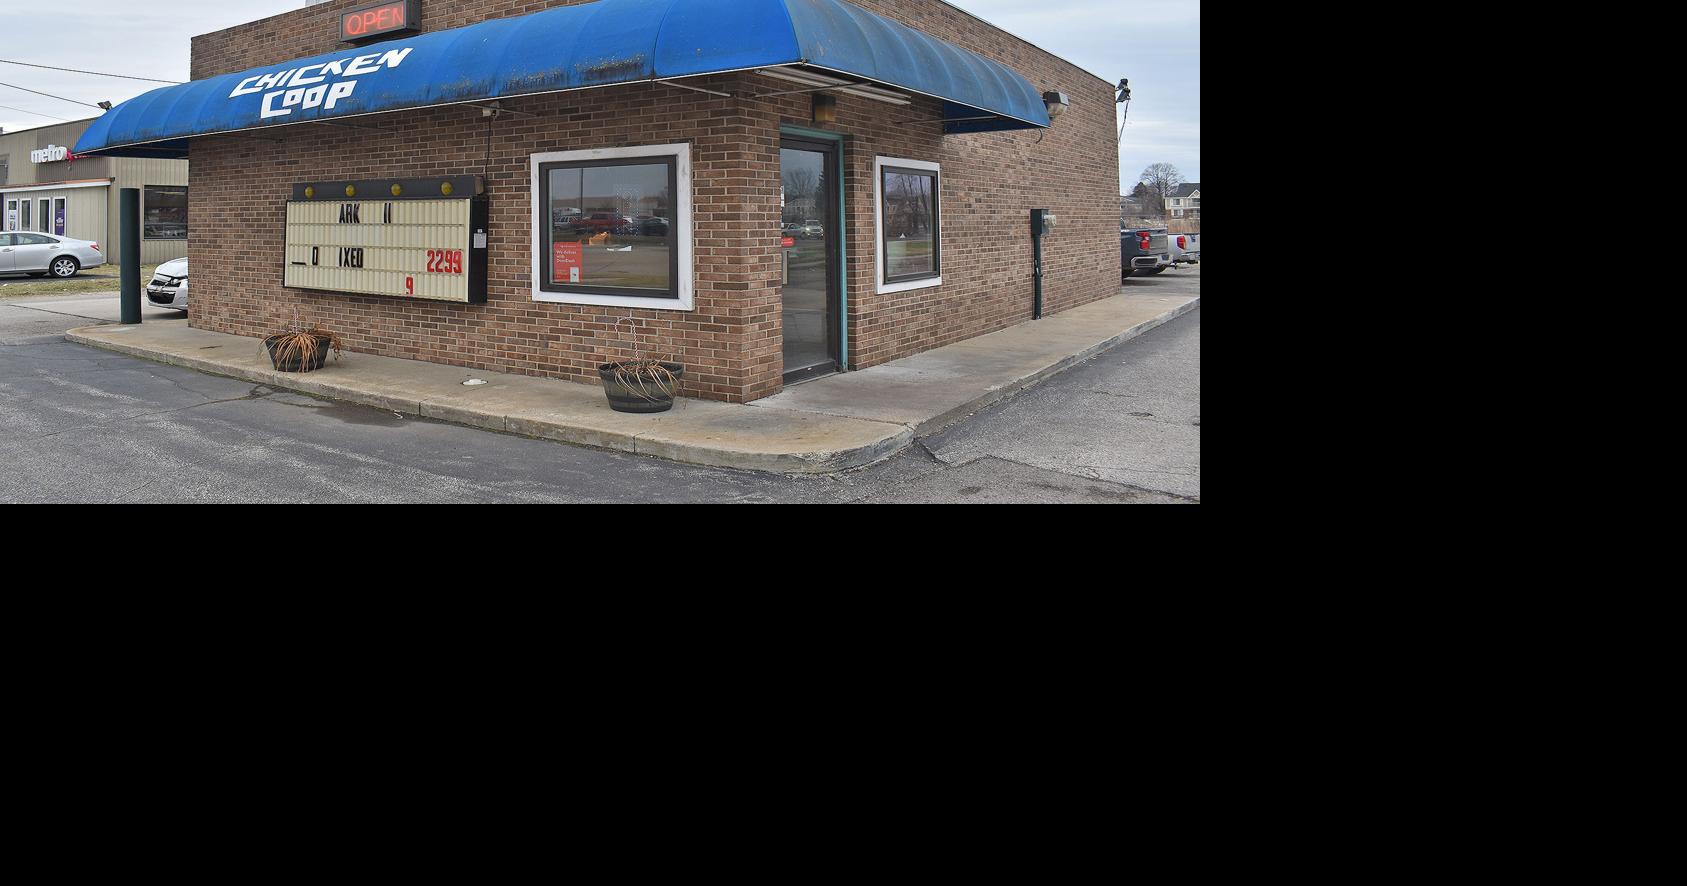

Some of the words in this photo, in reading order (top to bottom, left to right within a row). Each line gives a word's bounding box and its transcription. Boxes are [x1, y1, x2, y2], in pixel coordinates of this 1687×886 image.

[347, 3, 404, 35] OPEN
[228, 47, 413, 98] CHICKEN
[260, 79, 357, 119] COOP
[31, 144, 67, 164] metro
[338, 203, 360, 224] ARK
[426, 250, 462, 273] 2299
